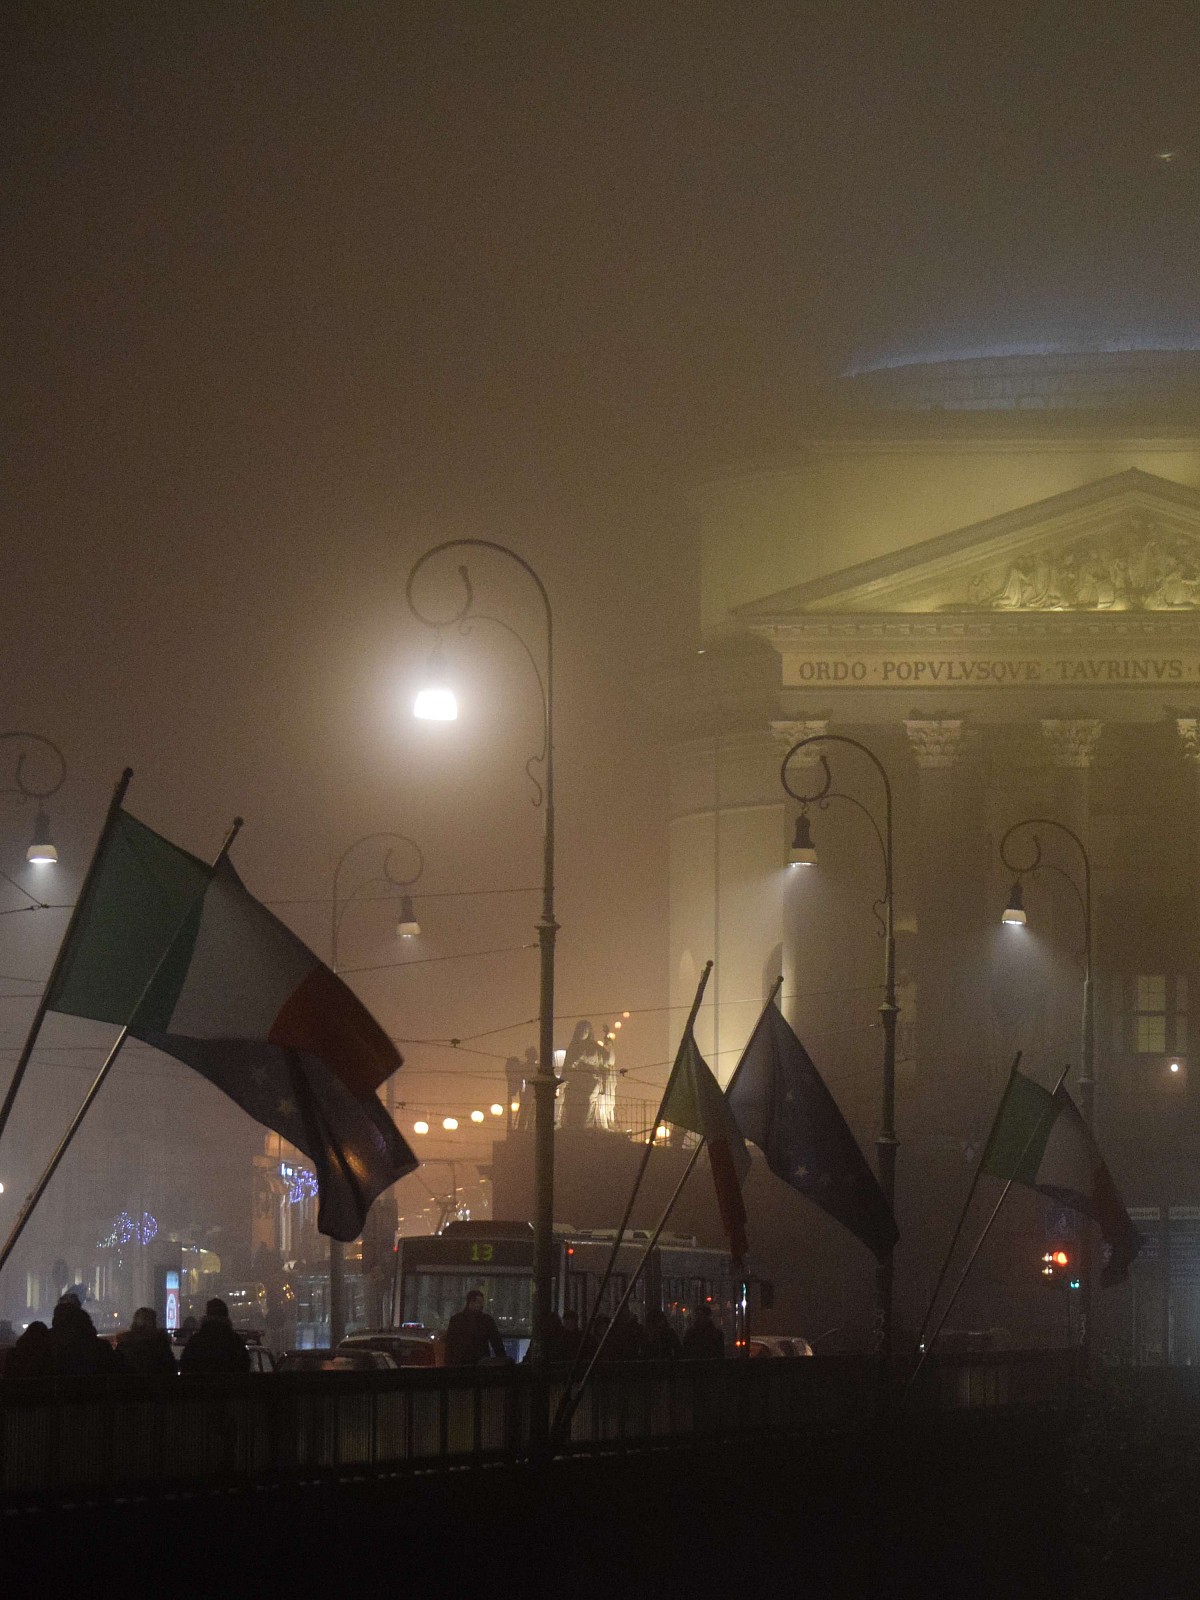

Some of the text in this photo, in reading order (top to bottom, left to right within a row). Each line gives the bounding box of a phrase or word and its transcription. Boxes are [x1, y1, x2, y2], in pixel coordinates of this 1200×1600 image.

[799, 662, 867, 681] ORDO
[881, 661, 1042, 682] POPVLVSQVE
[1056, 659, 1183, 679] TAVRINVS
[471, 1244, 494, 1261] 13
